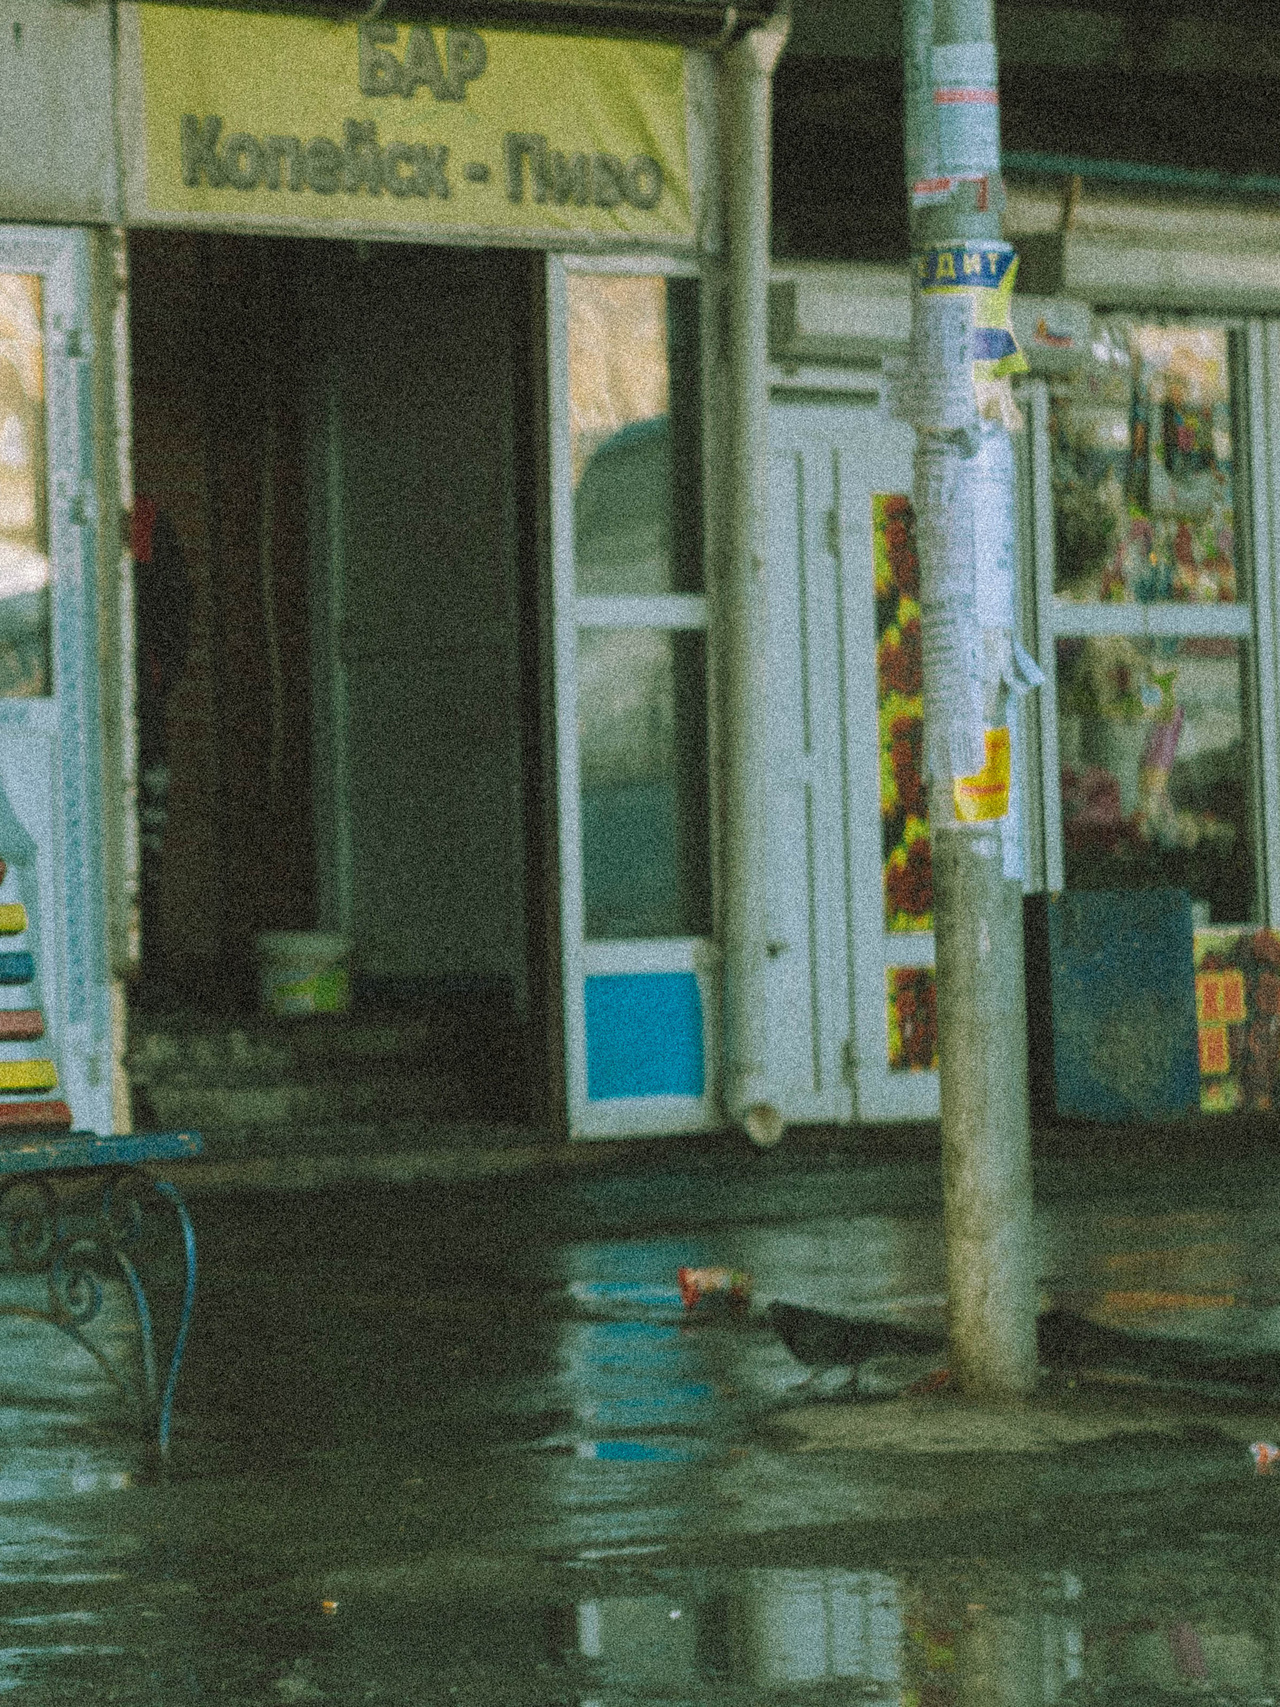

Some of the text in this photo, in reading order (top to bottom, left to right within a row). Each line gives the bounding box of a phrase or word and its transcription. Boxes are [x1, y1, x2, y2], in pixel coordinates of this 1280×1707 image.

[359, 22, 487, 102] БАР
[180, 112, 452, 201] Копейск
[504, 131, 664, 210] Пиво
